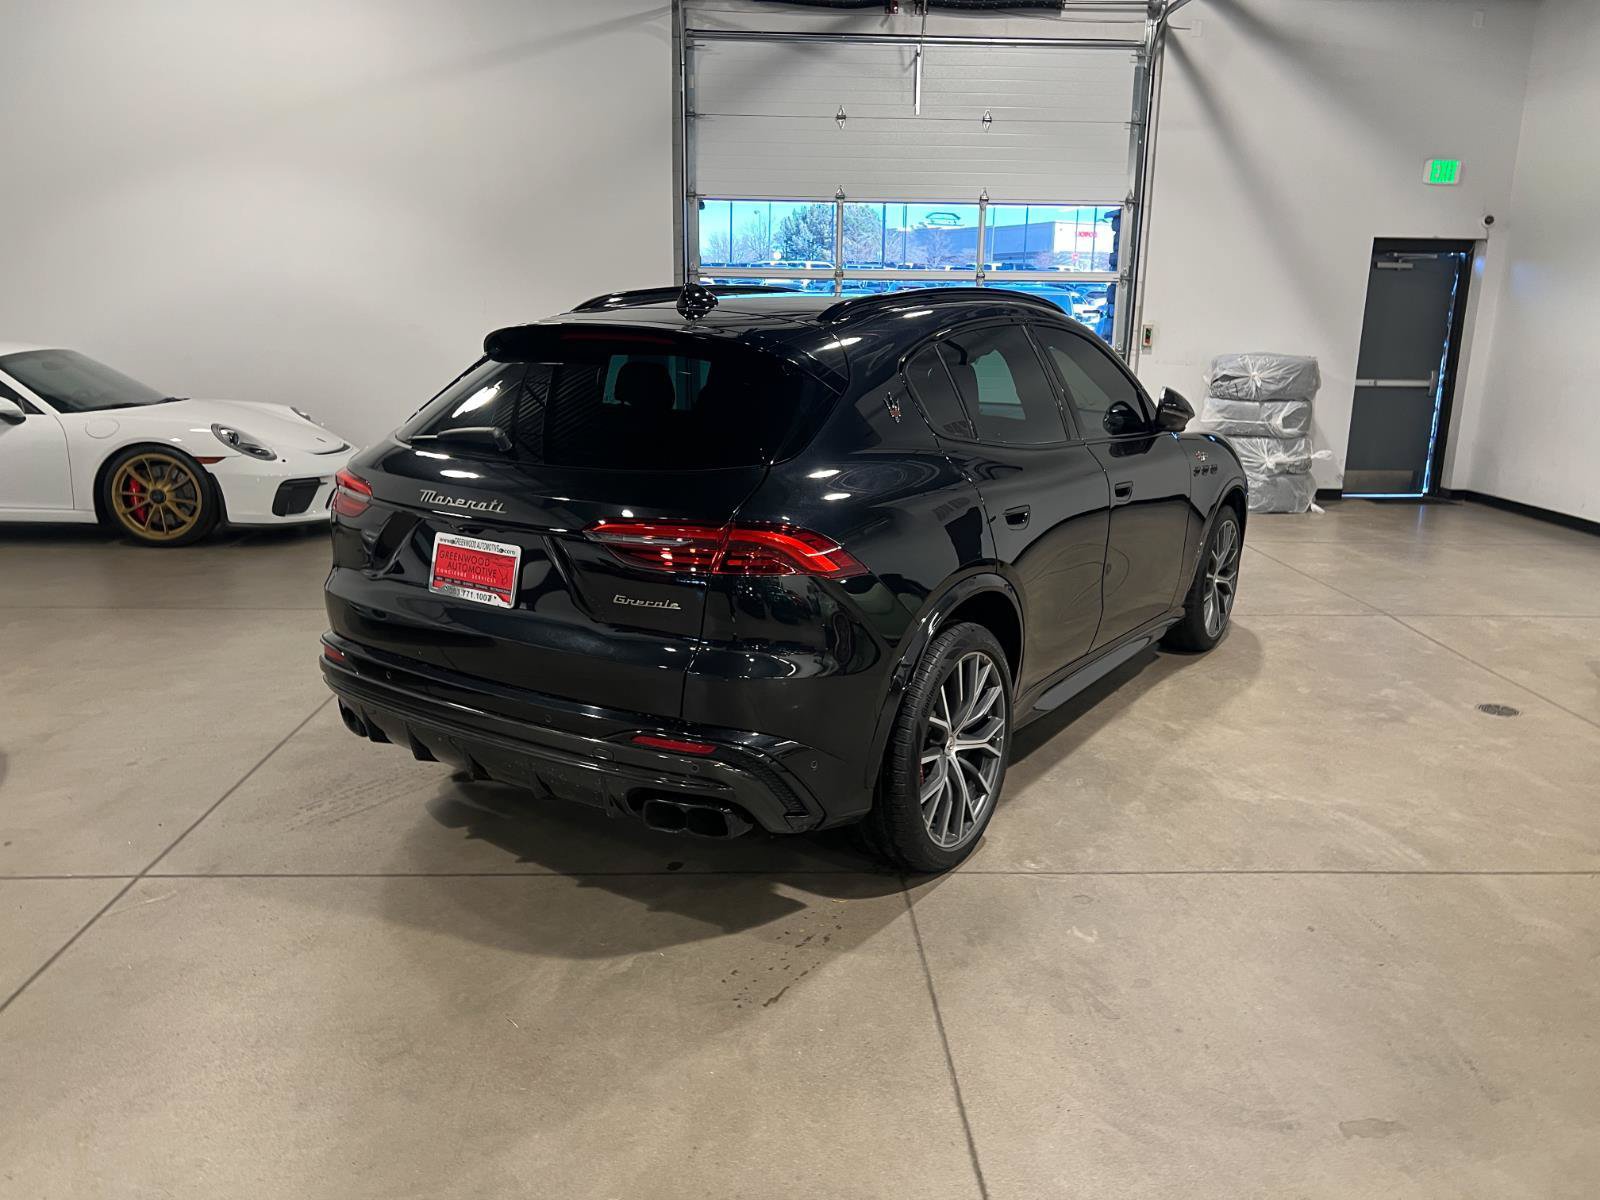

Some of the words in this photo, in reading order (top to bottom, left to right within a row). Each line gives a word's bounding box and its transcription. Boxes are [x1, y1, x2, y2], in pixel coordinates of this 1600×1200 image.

[420, 489, 506, 514] Maserati
[440, 550, 490, 567] GREENWOOD
[447, 561, 497, 578] AUTOMOTIVE
[613, 594, 681, 610] Grecale
